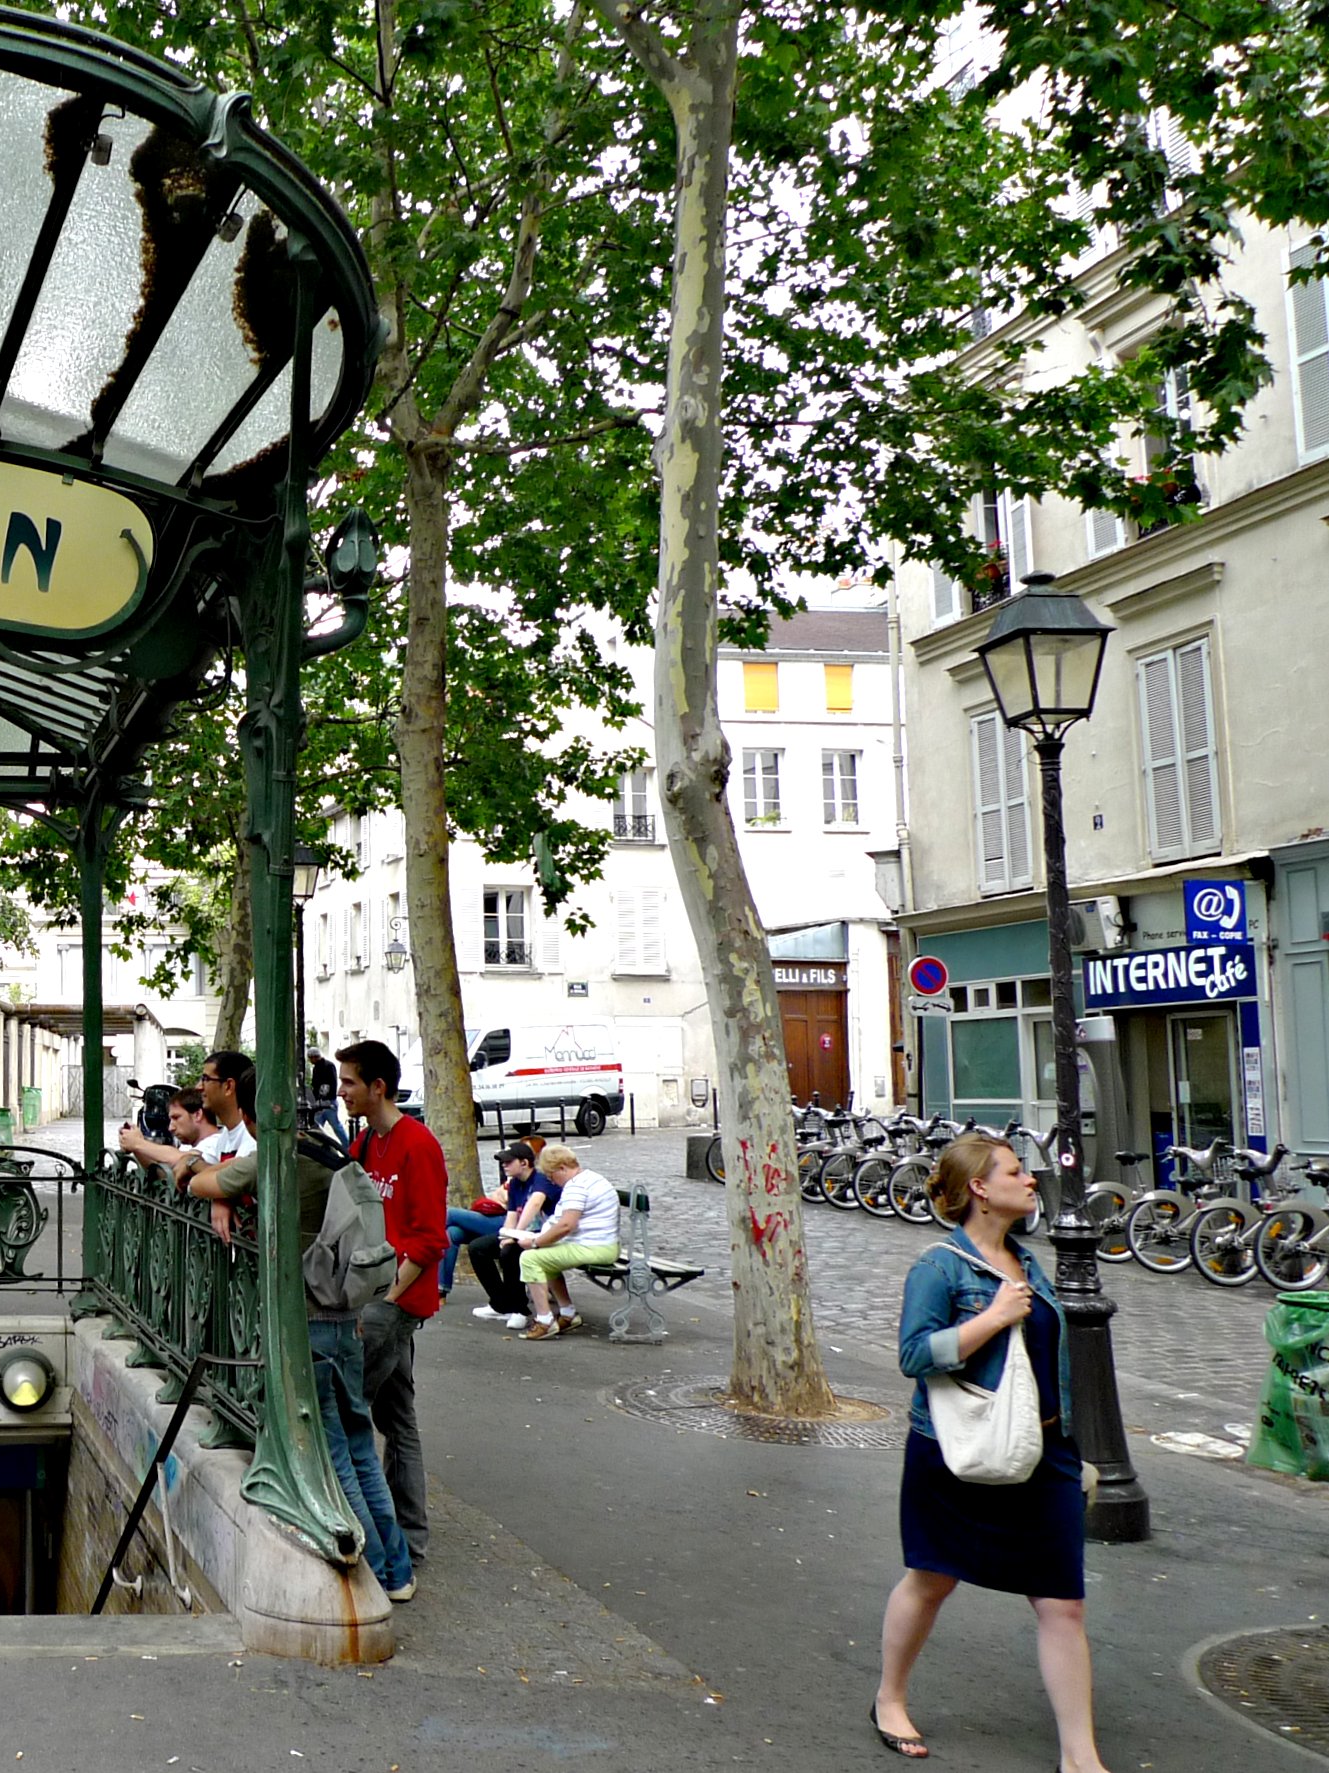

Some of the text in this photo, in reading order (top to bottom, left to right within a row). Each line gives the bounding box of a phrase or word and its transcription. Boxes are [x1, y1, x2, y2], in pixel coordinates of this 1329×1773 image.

[1192, 931, 1209, 939] FAX
[1219, 931, 1243, 939] COPIE
[809, 968, 836, 984] FILS
[1088, 946, 1226, 995] INTERNET
[1205, 955, 1248, 998] Café
